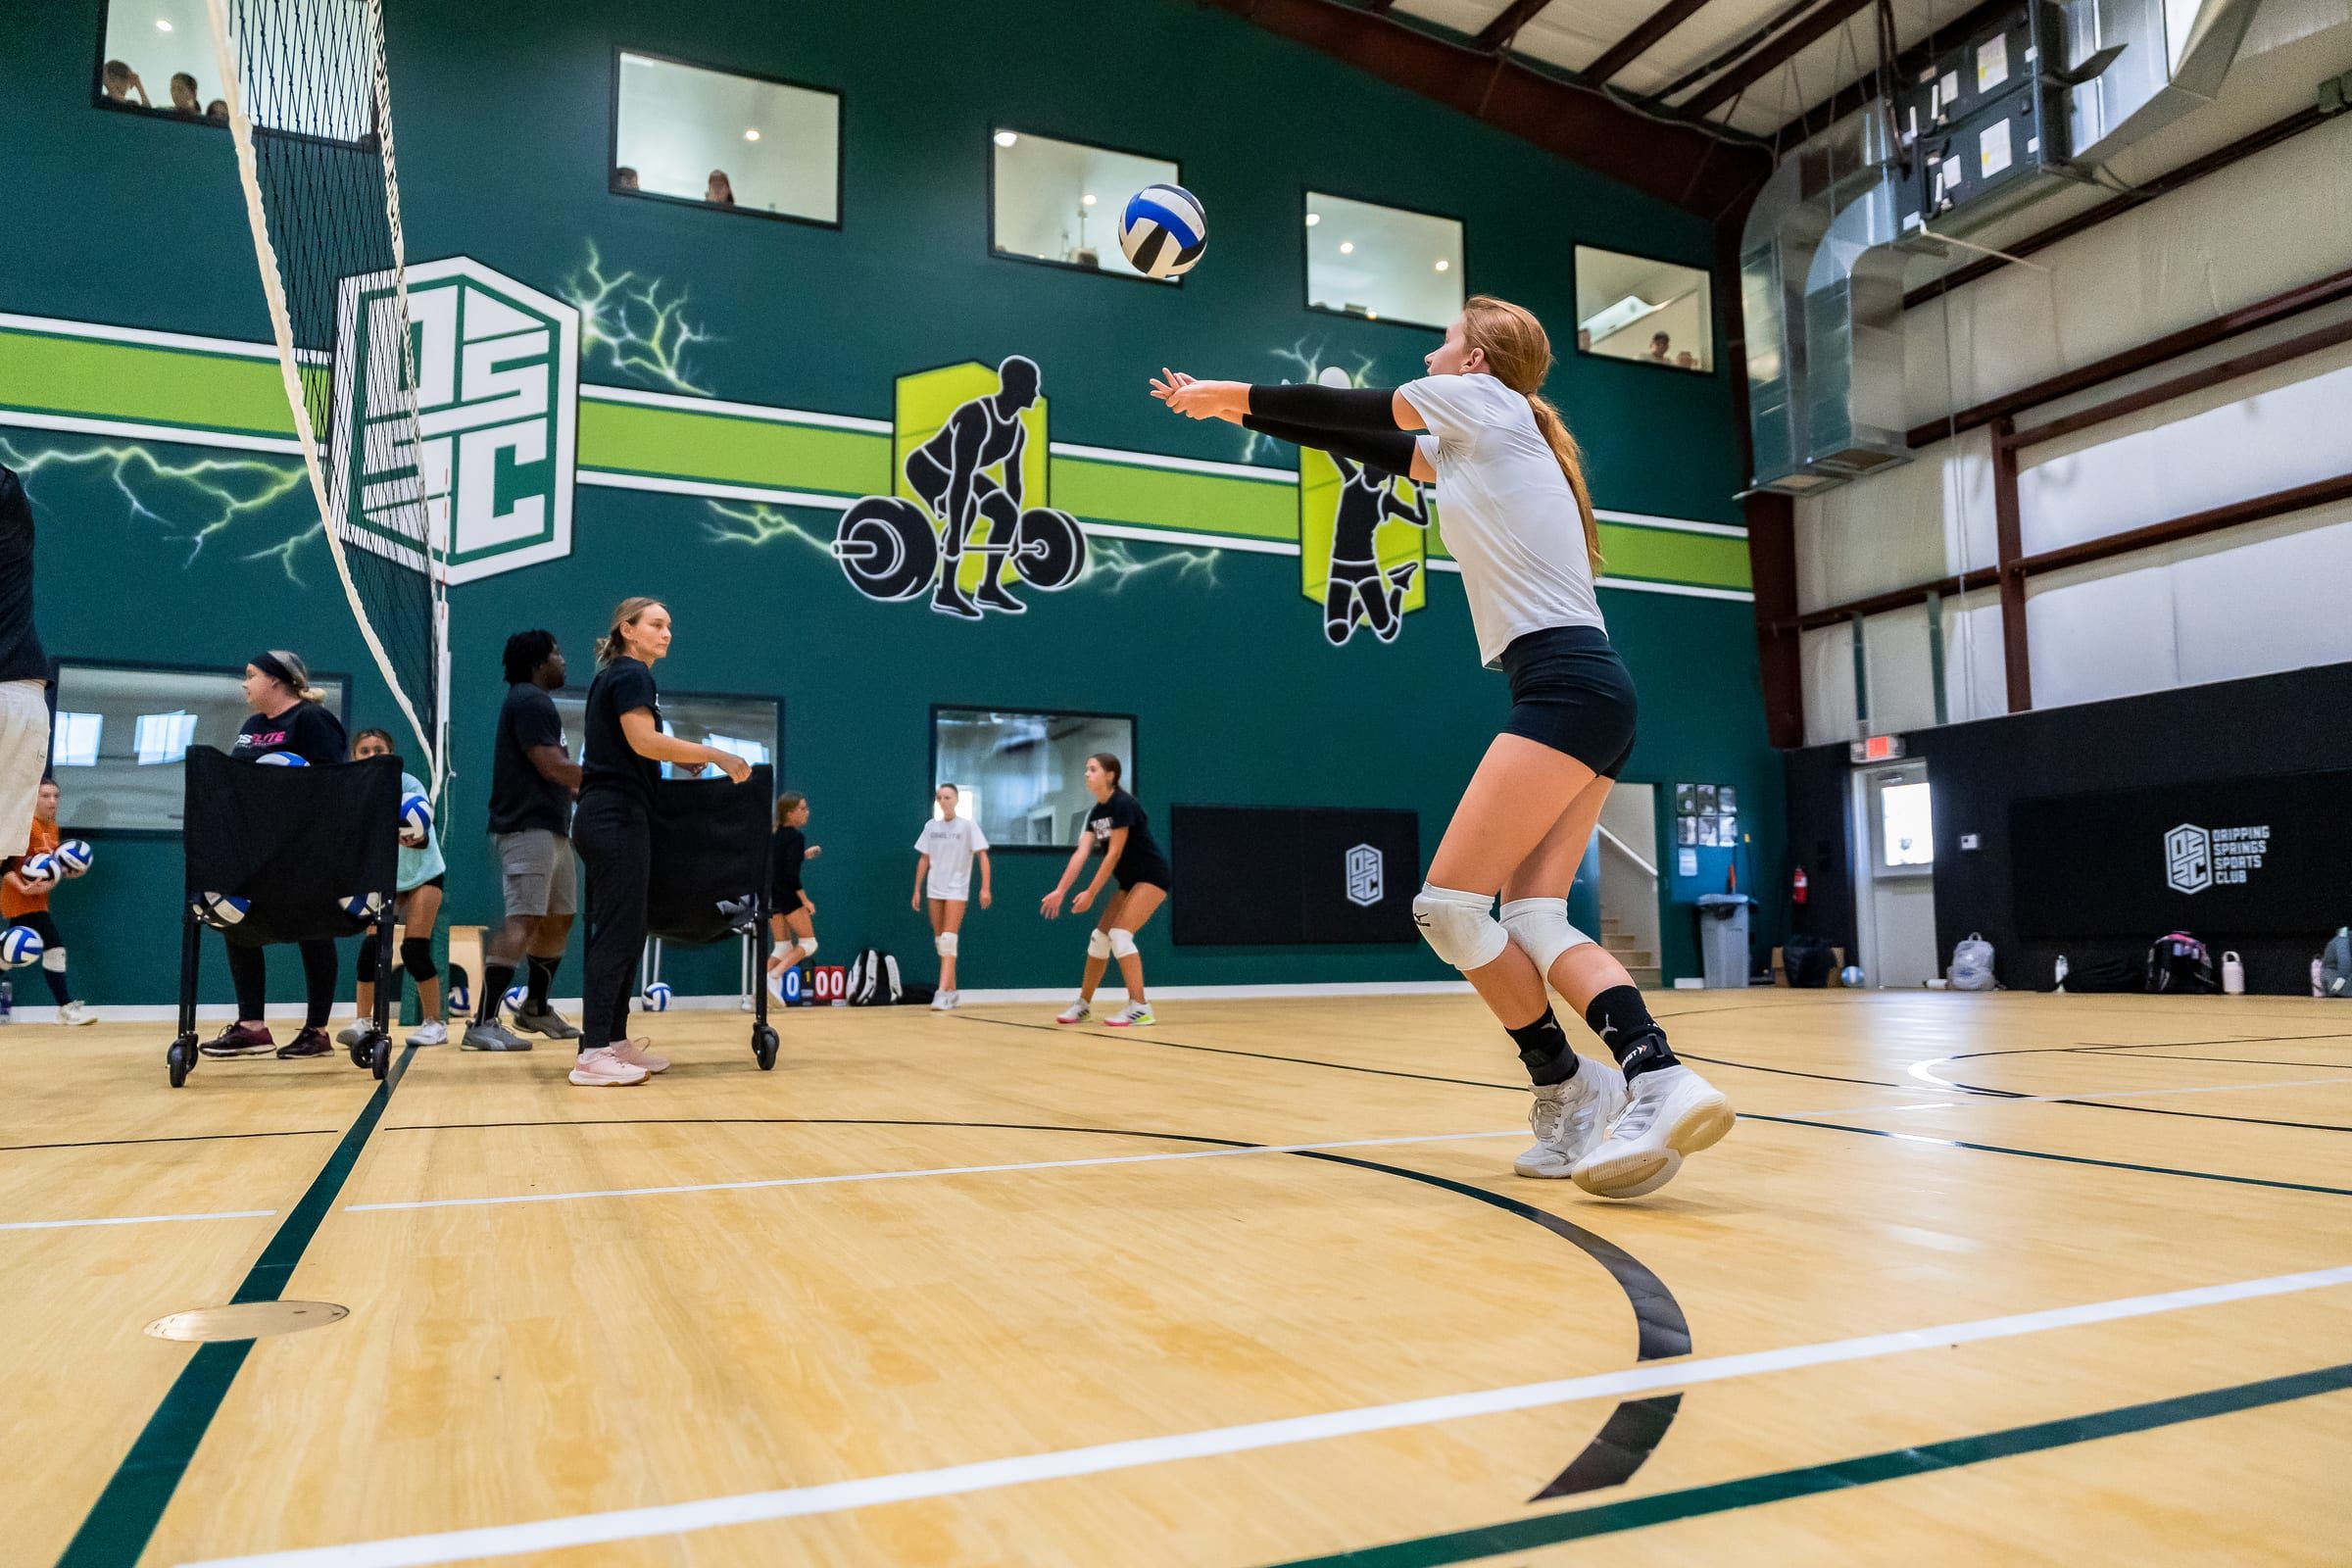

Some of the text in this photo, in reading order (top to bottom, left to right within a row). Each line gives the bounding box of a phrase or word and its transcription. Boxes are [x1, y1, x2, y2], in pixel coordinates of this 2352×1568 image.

[2212, 826, 2270, 842] DRIPPING
[2213, 840, 2267, 856] SPRINGS
[2214, 855, 2263, 870] SPORTS
[2216, 869, 2247, 884] CLUB
